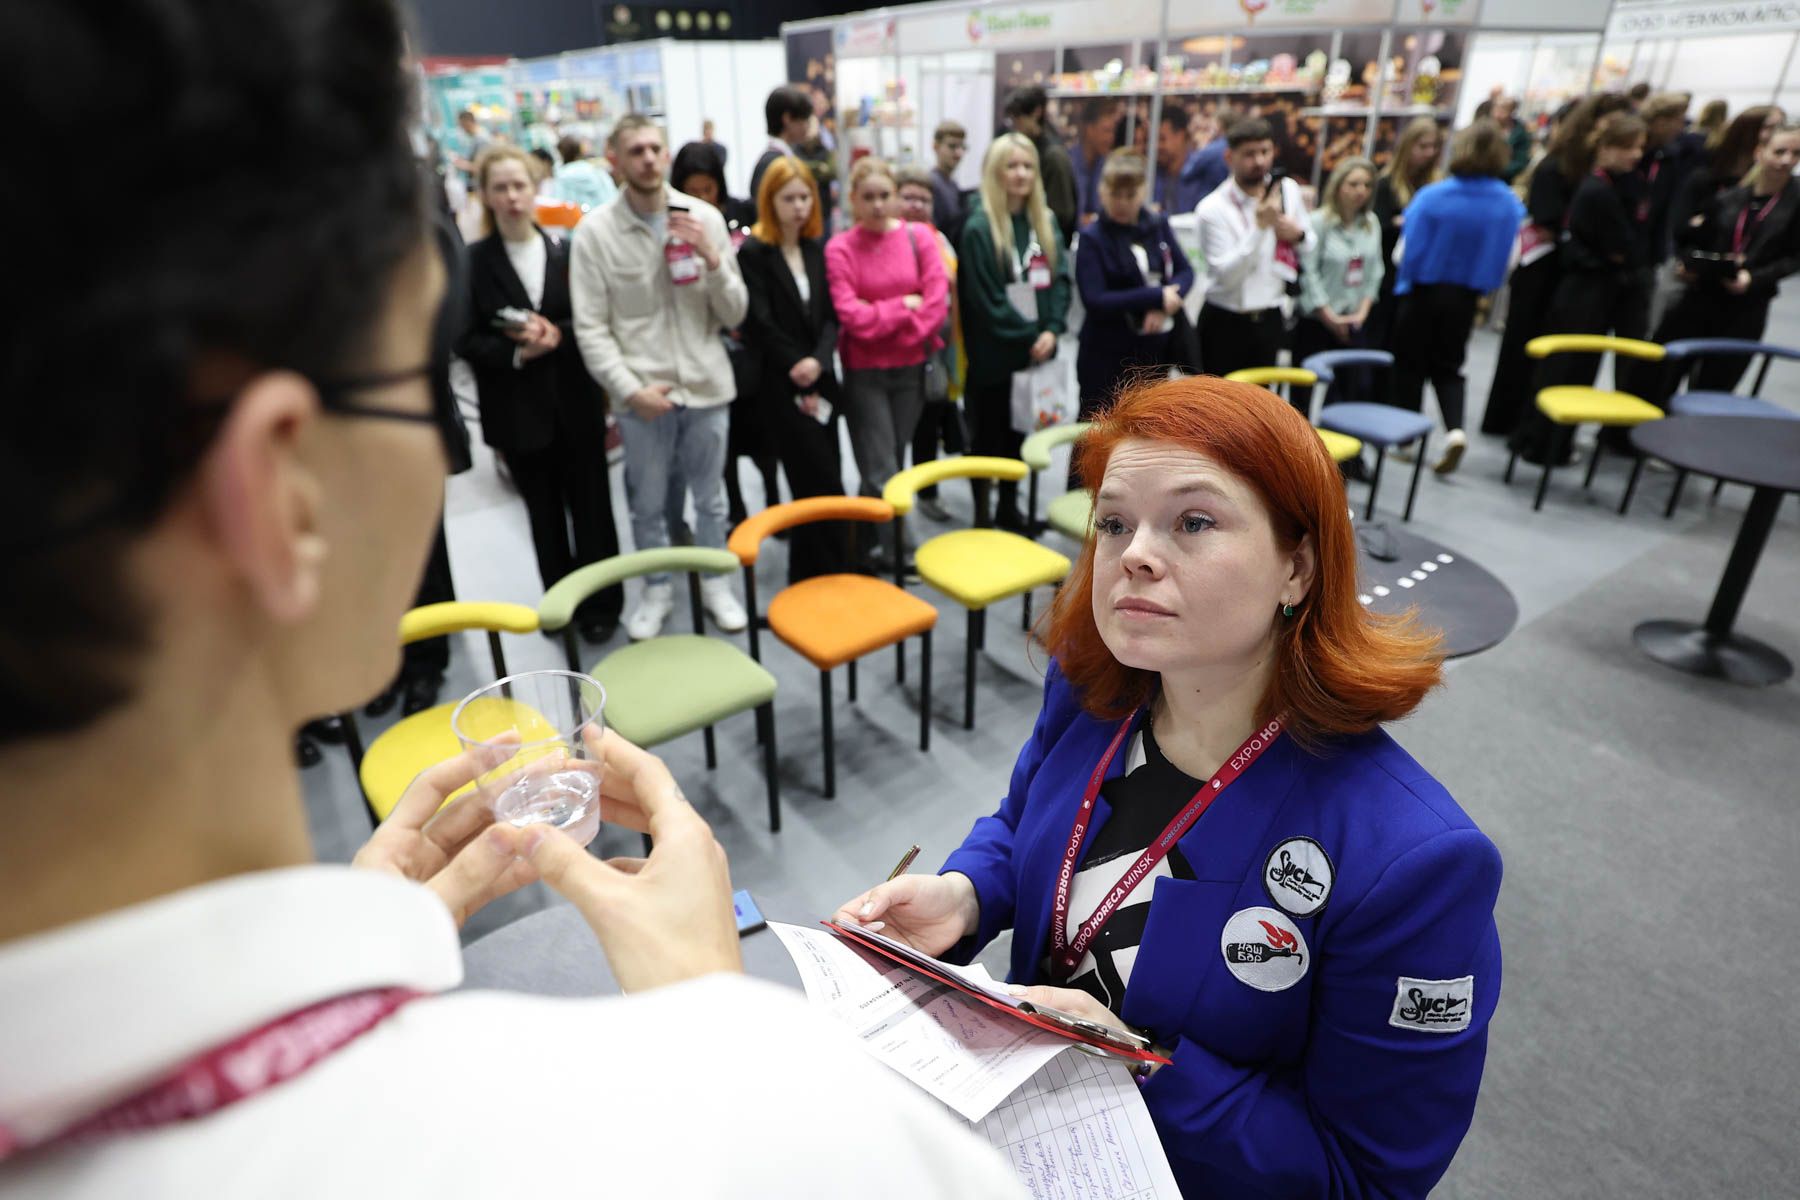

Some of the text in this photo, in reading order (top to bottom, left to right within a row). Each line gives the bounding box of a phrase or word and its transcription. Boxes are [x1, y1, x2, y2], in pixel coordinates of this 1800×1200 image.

[1230, 739, 1262, 771] EXPO
[1054, 823, 1084, 951] EXPO HORECA MINSK
[1073, 853, 1155, 953] EXPO HORECA MINSK
